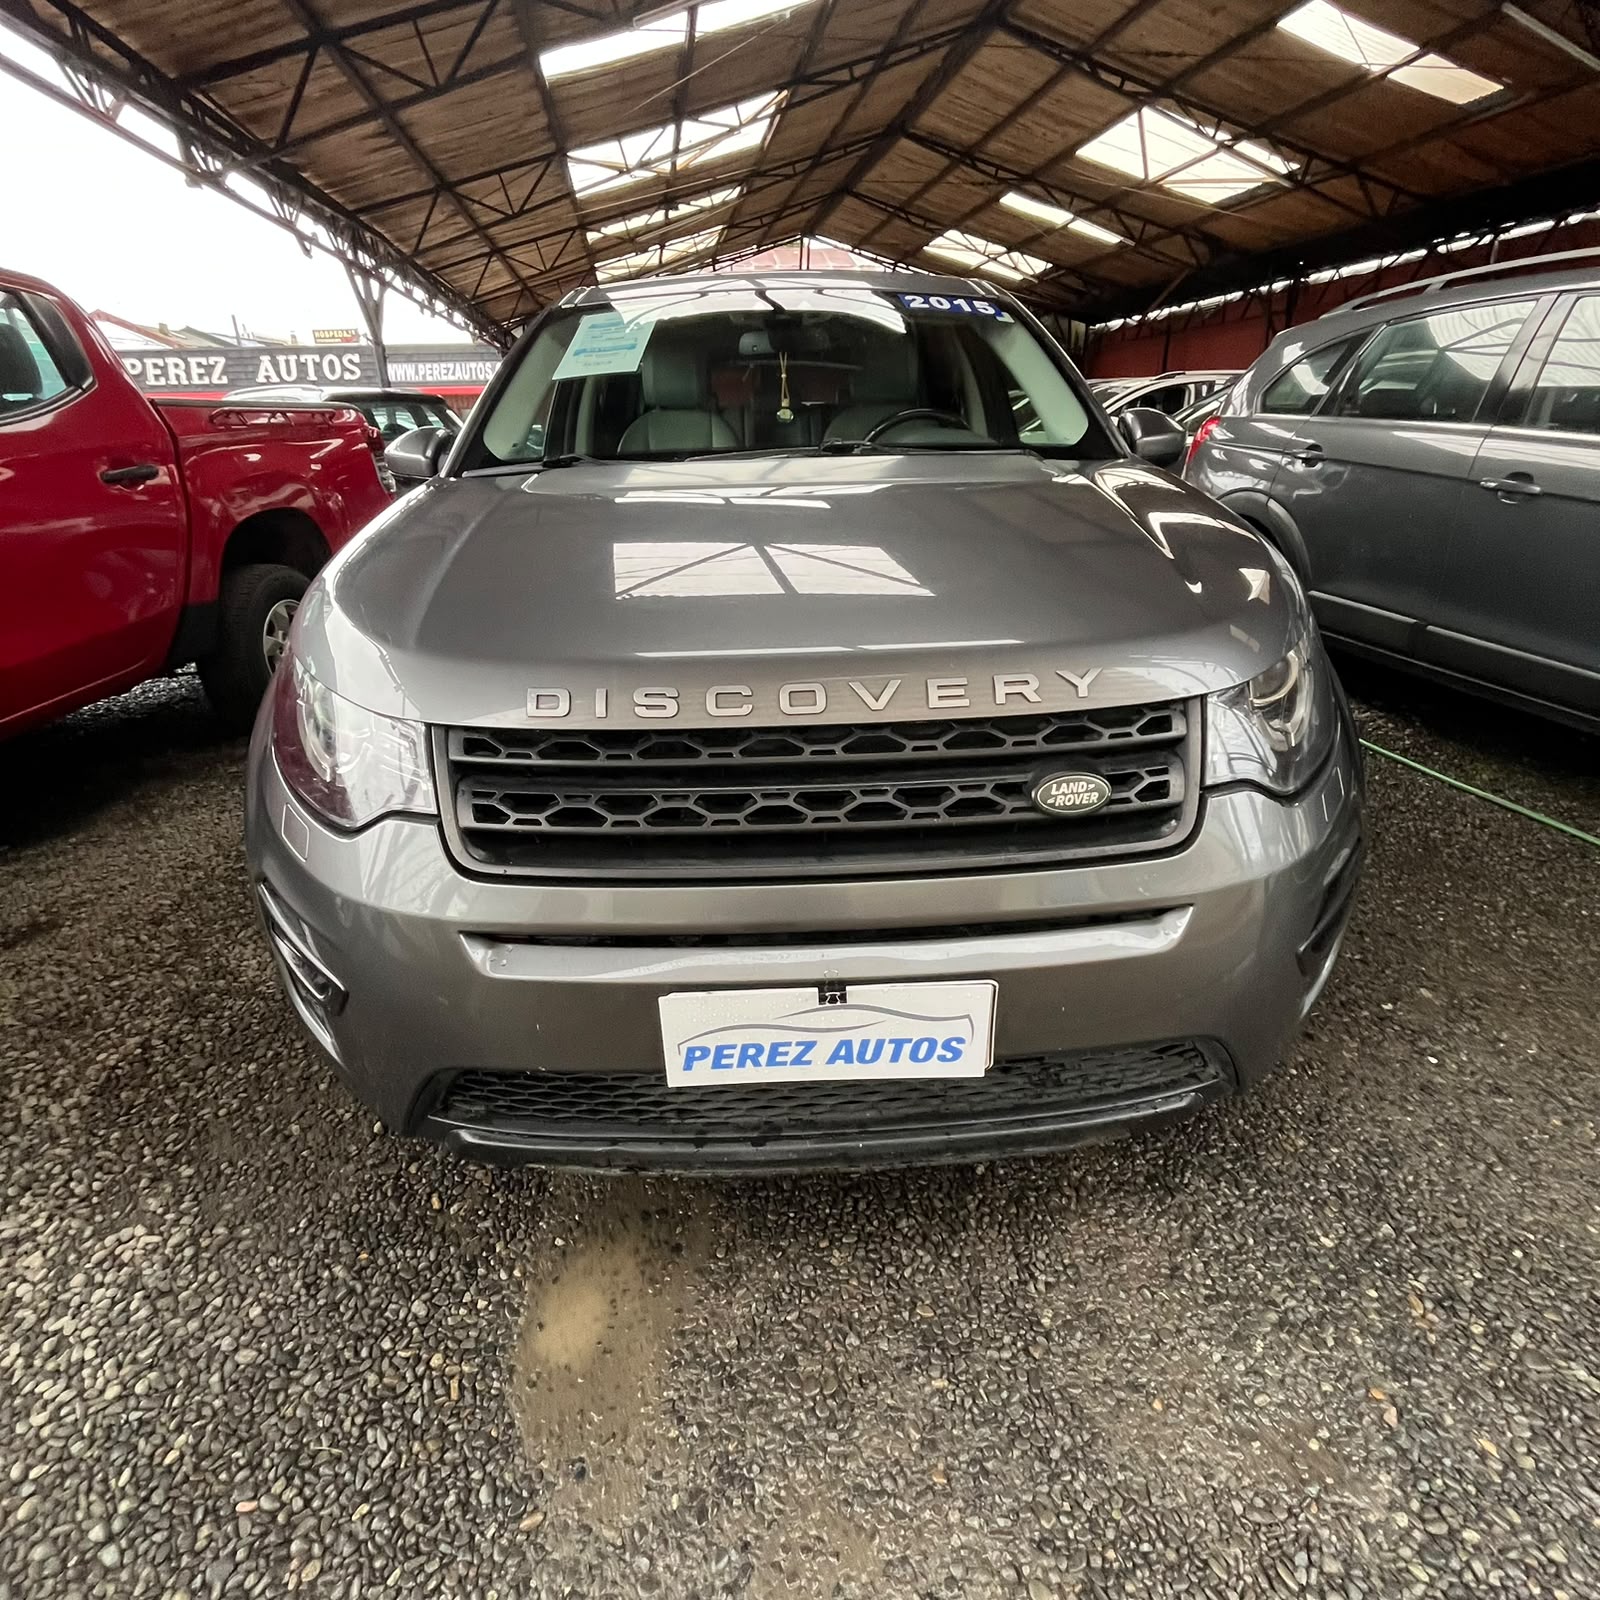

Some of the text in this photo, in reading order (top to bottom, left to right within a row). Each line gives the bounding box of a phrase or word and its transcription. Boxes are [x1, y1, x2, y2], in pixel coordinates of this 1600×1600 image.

[904, 295, 995, 315] 2015
[121, 353, 362, 386] PEREZ AUTOS
[387, 361, 501, 382] WWW.PEREZAUTOS
[526, 667, 1103, 719] DISCOVERY
[1051, 781, 1087, 795] LAND
[1055, 792, 1099, 807] ROVER
[682, 1036, 967, 1072] PEREZ AUTOS
